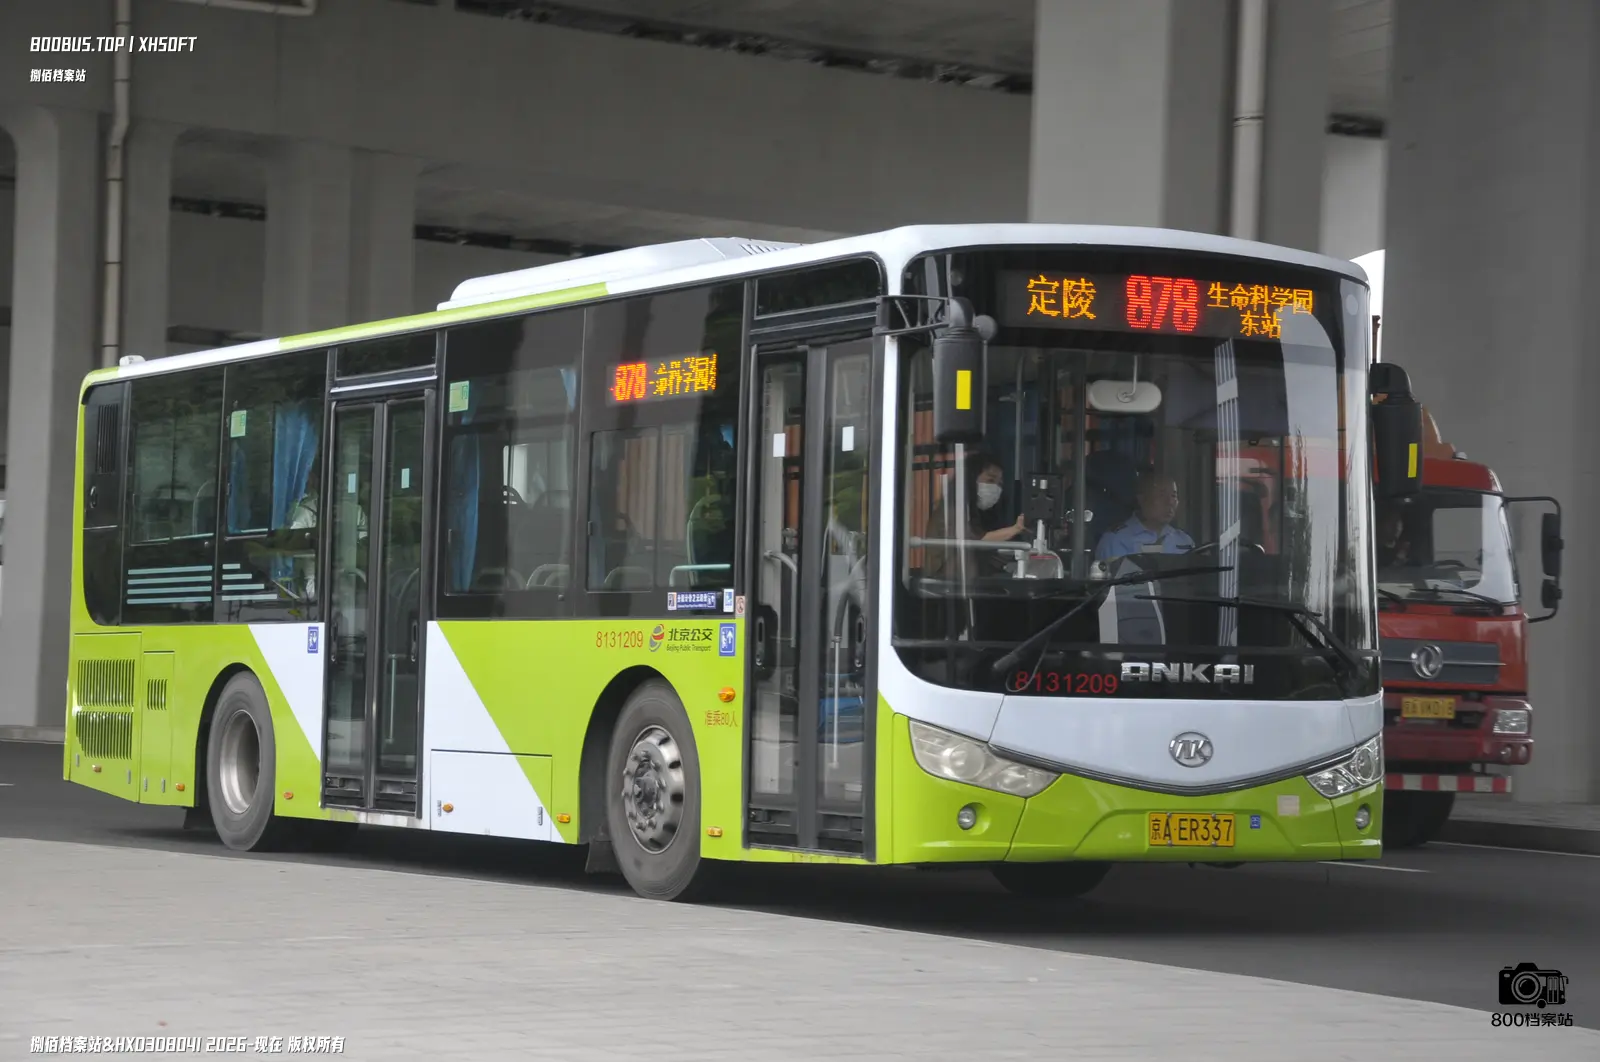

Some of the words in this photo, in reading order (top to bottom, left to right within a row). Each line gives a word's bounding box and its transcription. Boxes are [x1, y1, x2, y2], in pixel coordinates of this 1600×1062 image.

[1026, 274, 1097, 320] 定陵
[1126, 274, 1199, 332] 878
[1206, 281, 1314, 316] 生命科学园
[1239, 310, 1282, 339] 东站
[596, 631, 643, 648] 8131209
[668, 628, 713, 641] 北京公交
[1014, 671, 1119, 694] 8131209
[1120, 662, 1255, 685] ANKAI
[704, 709, 739, 728] 准乘80人
